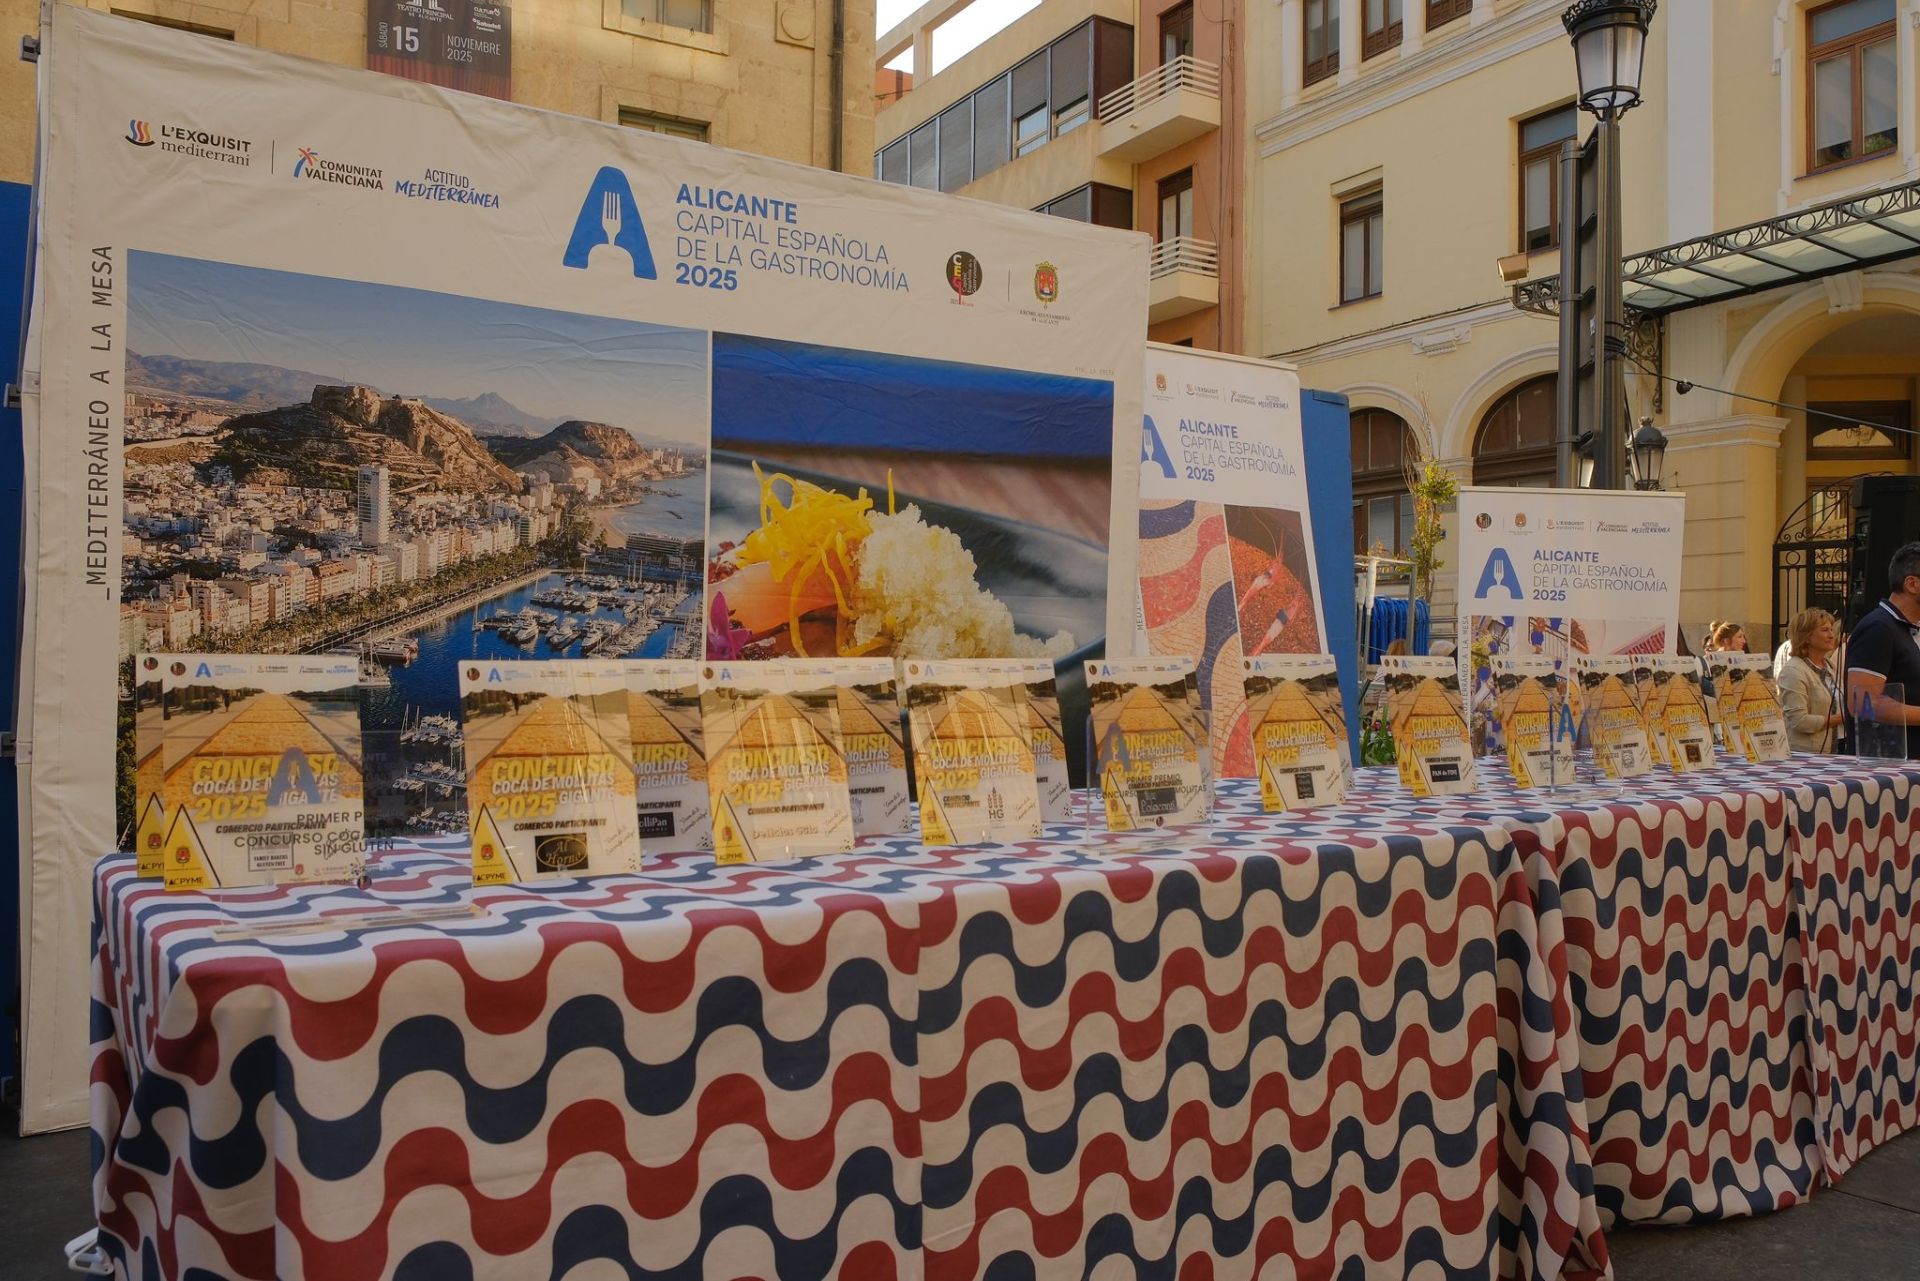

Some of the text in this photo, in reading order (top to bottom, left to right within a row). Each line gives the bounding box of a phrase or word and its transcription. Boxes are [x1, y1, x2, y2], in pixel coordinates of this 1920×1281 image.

[397, 3, 454, 20] TEATRO PRINCIPAL
[393, 25, 419, 52] 15
[447, 35, 501, 55] NOVIEMBRE
[447, 48, 473, 62] 2025
[161, 141, 250, 167] mediterrani
[320, 159, 383, 178] COMUNITAT
[424, 168, 469, 188] ACTITUD
[305, 167, 384, 190] VALENCIANA
[395, 179, 500, 208] MEDITERRÁNEA
[676, 183, 798, 225] ALICANTE
[677, 210, 889, 265] CAPITAL ESPAÑOLA
[677, 236, 910, 292] DE LA GASTRONOMÍA
[92, 246, 113, 307] MESA
[676, 262, 738, 291] 2025
[91, 323, 112, 352] LA
[90, 370, 110, 385] A
[1179, 418, 1239, 439] ALICANTE
[1180, 434, 1284, 460] CAPITAL ESPAÑOLA
[1184, 450, 1297, 477] DE LA GASTRONOMÍA
[1186, 466, 1215, 482] 2025
[1533, 549, 1599, 563] ALICANTE
[1533, 562, 1655, 578] CAPITAL ESPAÑOLA
[1533, 576, 1668, 593] DE LA GASTRONOMÍA
[1533, 589, 1566, 601] 2025
[1264, 721, 1325, 740] CONCURSO
[1412, 716, 1460, 733] CONCURSO
[931, 738, 1019, 759] CONCURSO
[1416, 739, 1440, 755] 2025
[728, 745, 830, 770] CONCURSO
[932, 757, 959, 769] COCA
[961, 756, 974, 768] DE
[1270, 747, 1298, 768] 2025
[492, 753, 616, 782] CONCURSO
[634, 760, 688, 775] MOLLITAS
[729, 768, 760, 783] COCA
[849, 761, 890, 776] GIGANTE
[192, 777, 264, 796] COCA DE
[492, 772, 615, 795] COCA DE MOLLITAS
[640, 773, 689, 789] GIGANTE
[936, 769, 979, 792] 2025
[1126, 773, 1181, 784] PRIMER PREMIO
[731, 780, 784, 807] 2025
[1096, 789, 1138, 800] CONCURSO
[193, 795, 268, 821] 2025
[495, 793, 556, 820] 2025
[989, 810, 1004, 819] HG
[216, 820, 327, 834] COMERCIO PARTICIPANTE
[297, 812, 350, 824] PRIMER
[514, 818, 607, 831] COMERCIO PARTICIPANTE
[234, 832, 323, 848] CONCURSO
[314, 841, 395, 856] SIN GLUTEN
